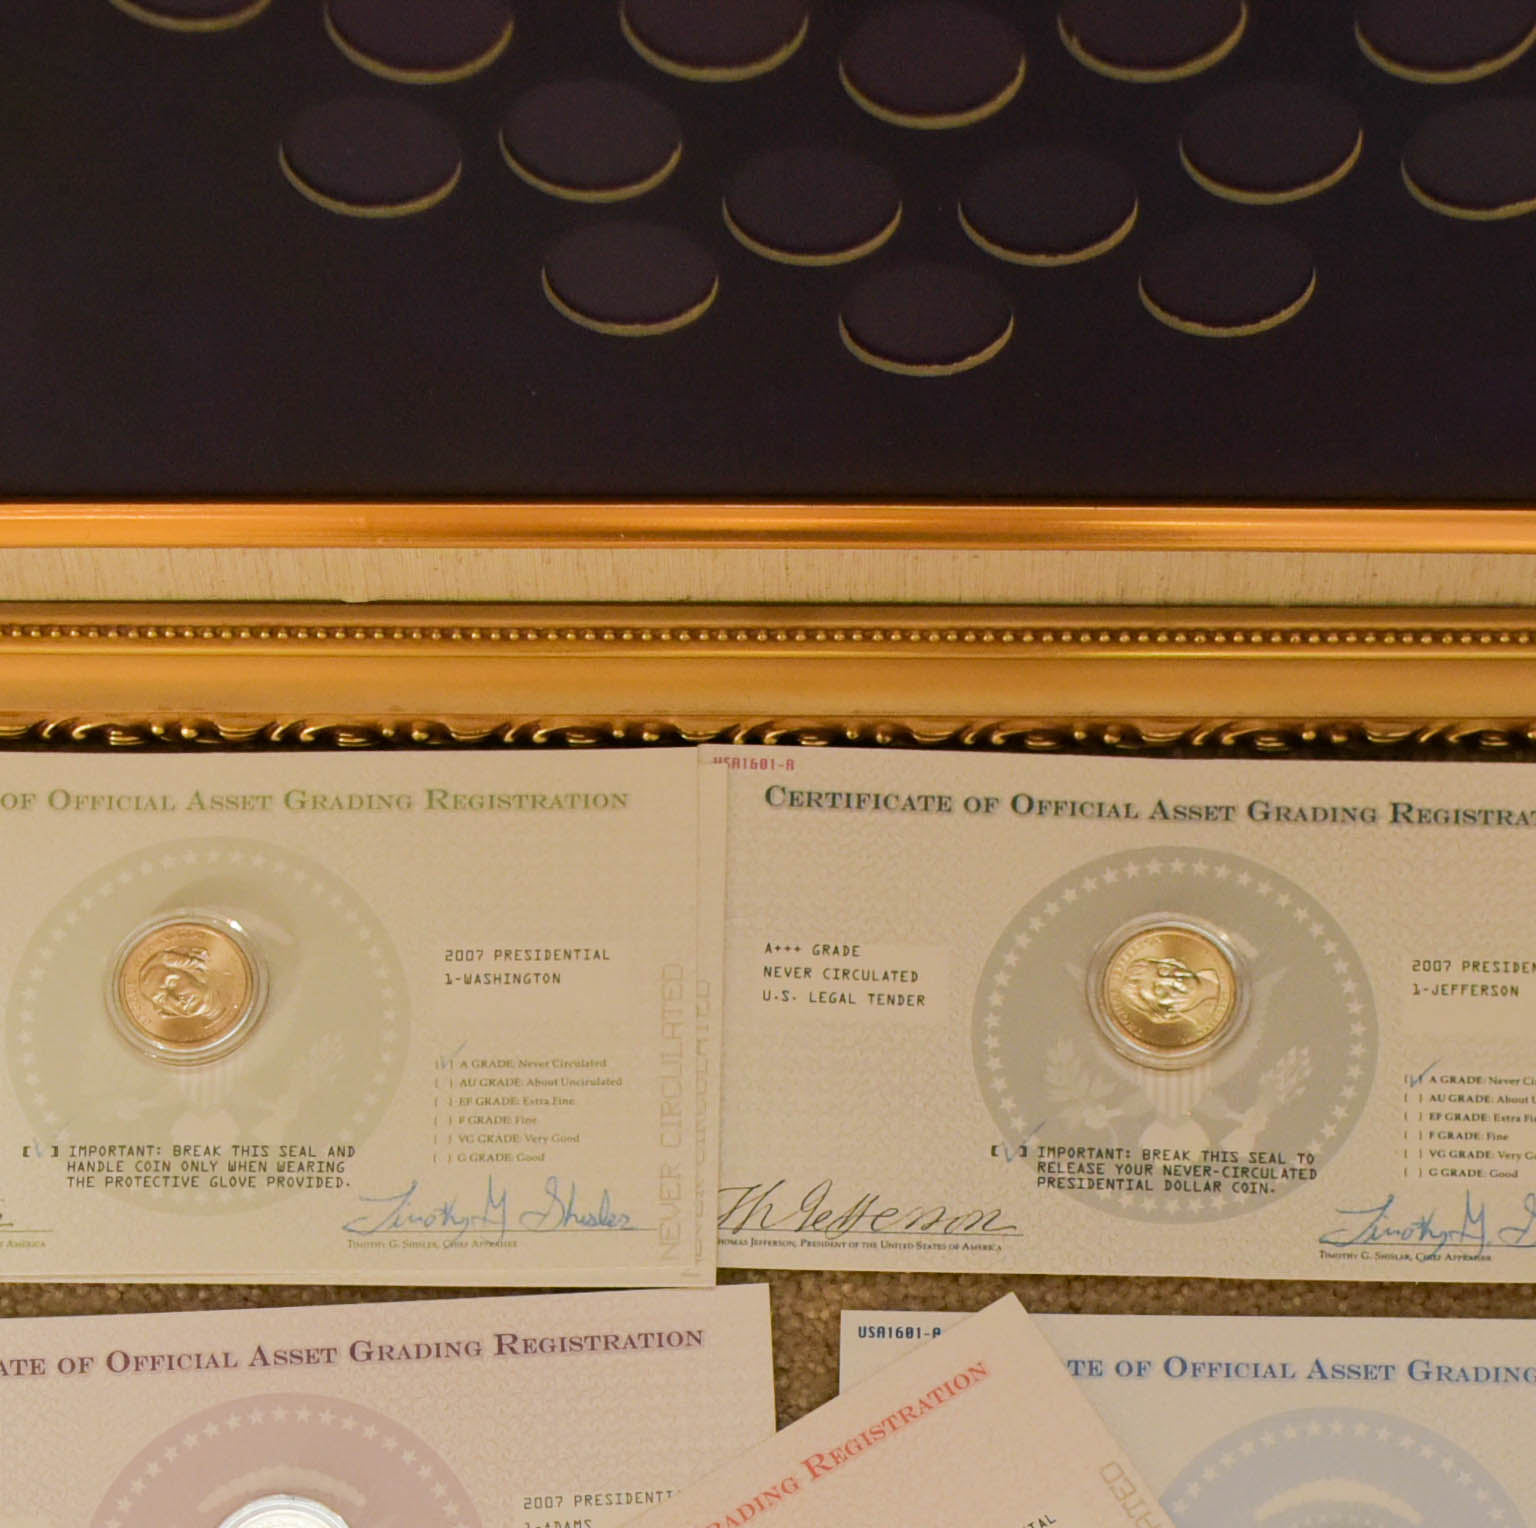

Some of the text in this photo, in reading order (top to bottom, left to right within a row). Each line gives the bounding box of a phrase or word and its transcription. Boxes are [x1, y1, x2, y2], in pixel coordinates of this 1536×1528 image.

[0, 792, 37, 812] OF
[46, 788, 176, 813] OFFICIAL
[184, 790, 273, 813] ASSET
[282, 788, 413, 813] GRADING
[423, 787, 628, 812] REGISTRATION
[764, 784, 953, 814] CERTIFICATE
[962, 796, 1000, 815] OF
[1009, 792, 1140, 820] OFFICIAL
[1147, 799, 1237, 823] ASSET
[1246, 799, 1377, 824] GRADING
[444, 948, 610, 963] 2007 PRESIDENTIAL
[1411, 959, 1452, 973] 2007
[444, 972, 561, 986] 1-WASHINGTON
[1412, 982, 1520, 998] 1-JEFFERSON
[56, 1356, 95, 1375] OF
[105, 1349, 239, 1374] OFFICIAL
[247, 1344, 338, 1368] ASSET
[348, 1339, 483, 1363] GRADING
[493, 1329, 704, 1356] REGISTRATION
[1113, 1360, 1152, 1378] OF
[1163, 1355, 1296, 1379] OFFICIAL
[1305, 1358, 1396, 1381] ASSET
[799, 1361, 988, 1482] REGISTRATION
[523, 1489, 681, 1511] 2007 PRESIDENTI
